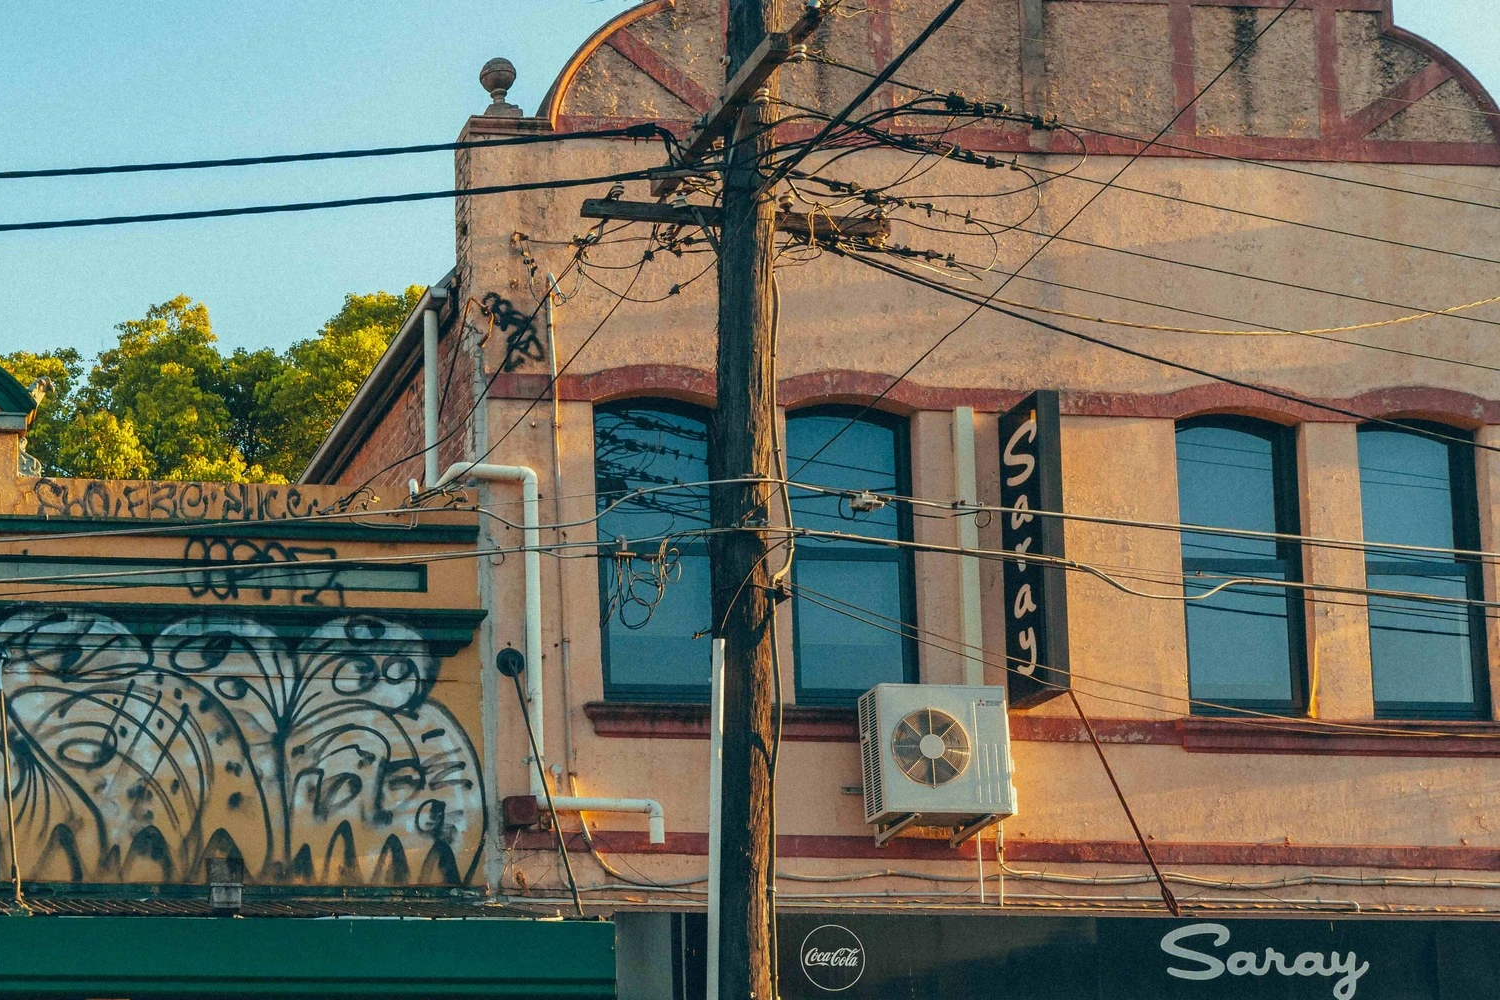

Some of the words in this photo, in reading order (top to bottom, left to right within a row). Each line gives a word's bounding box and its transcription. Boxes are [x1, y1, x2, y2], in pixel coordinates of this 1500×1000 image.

[1003, 409, 1037, 677] Saray
[804, 947, 861, 967] Coca-Cola
[1160, 922, 1370, 1000] Saray
